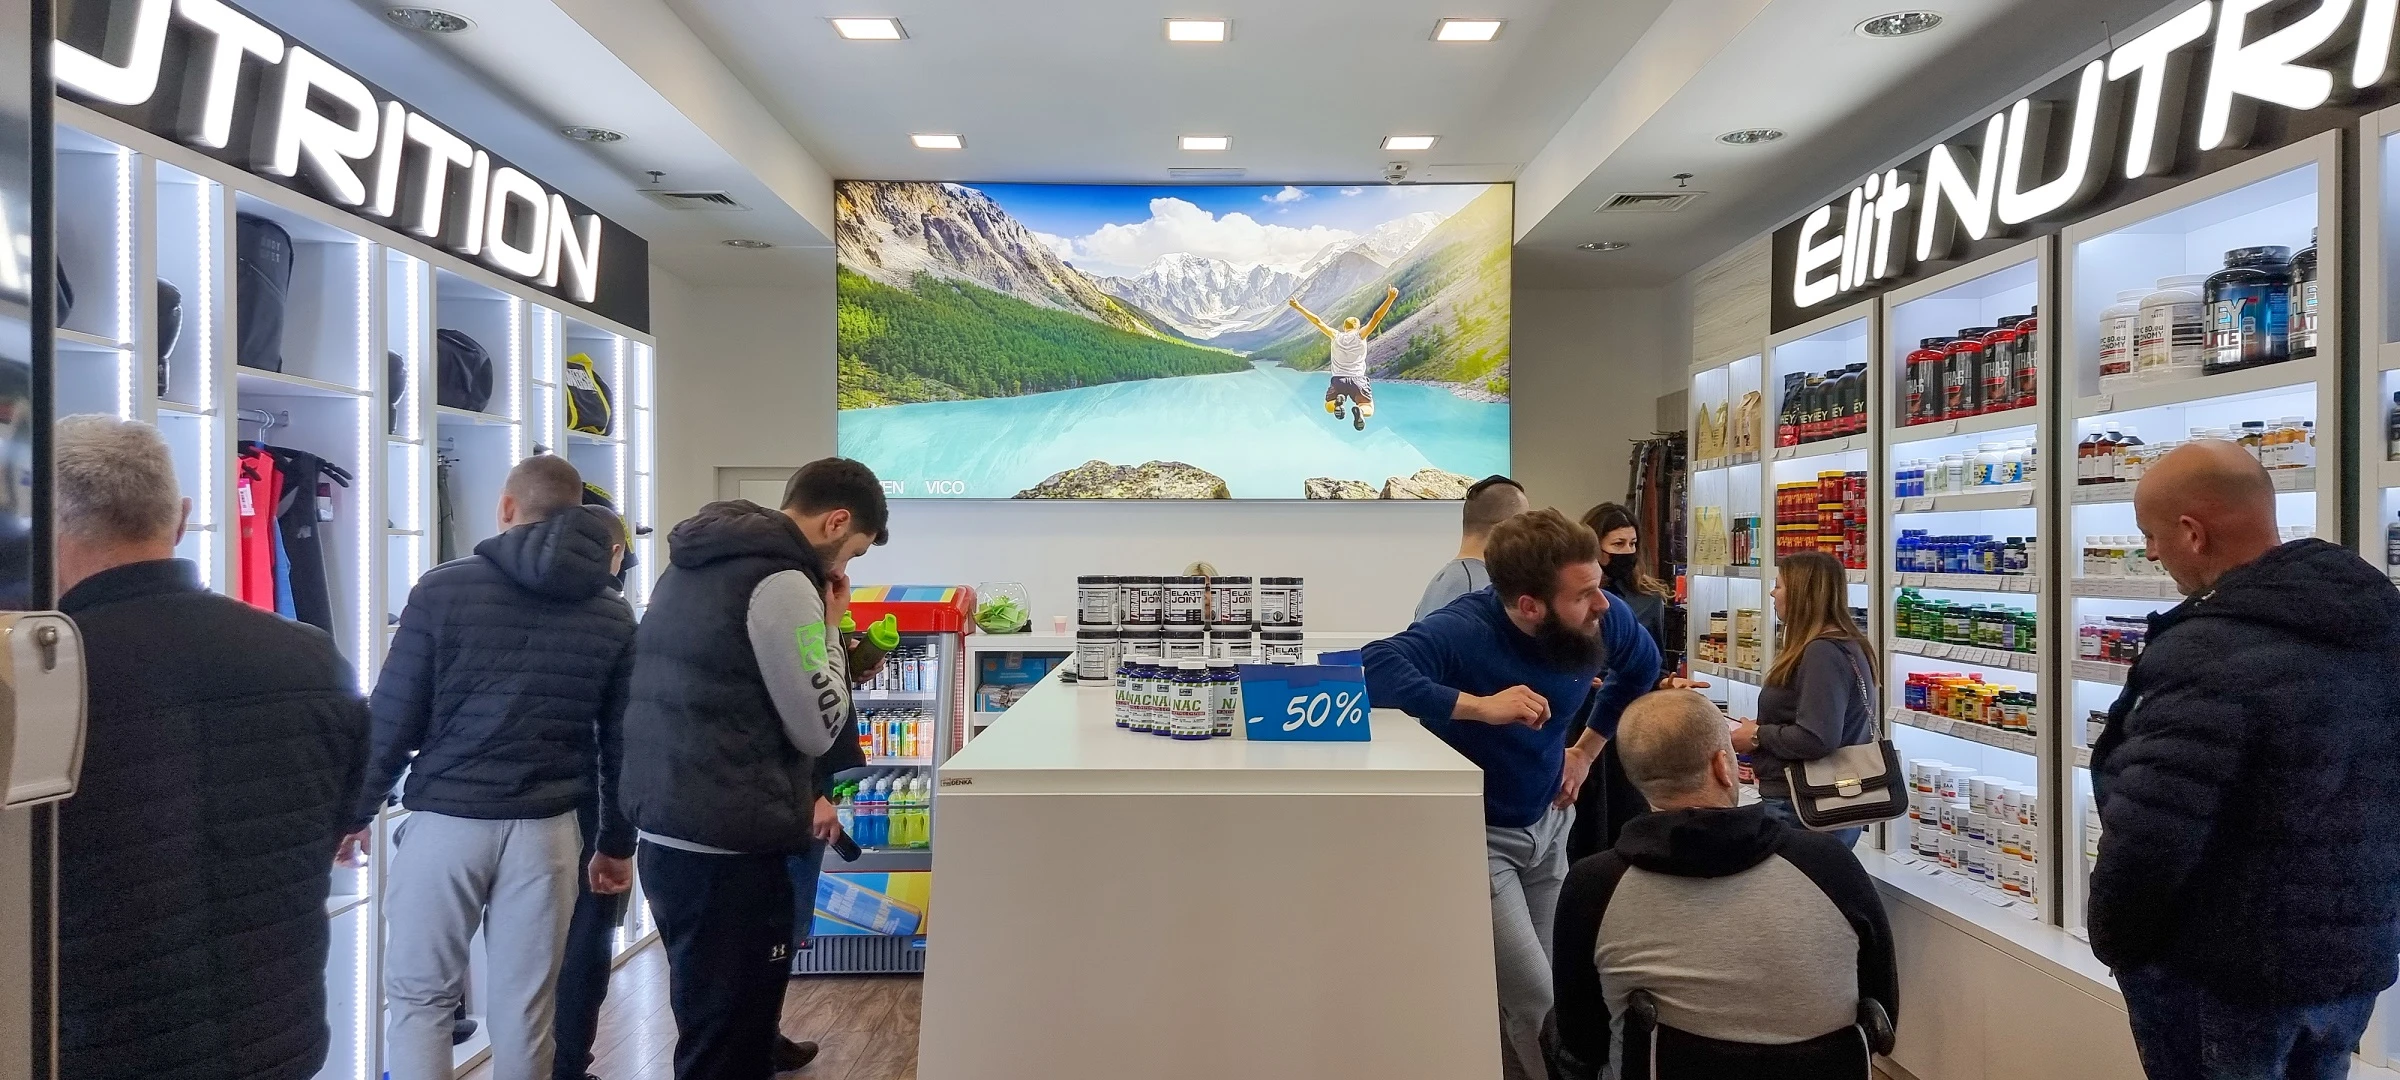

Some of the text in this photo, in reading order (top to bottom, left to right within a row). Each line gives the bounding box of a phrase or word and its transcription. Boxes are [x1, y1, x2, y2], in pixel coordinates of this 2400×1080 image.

[1793, 168, 1911, 308] Elit
[880, 480, 965, 495] EN VICO
[1171, 596, 1202, 604] JOINT
[1172, 699, 1202, 712] NAC
[1282, 691, 1363, 732] 50%
